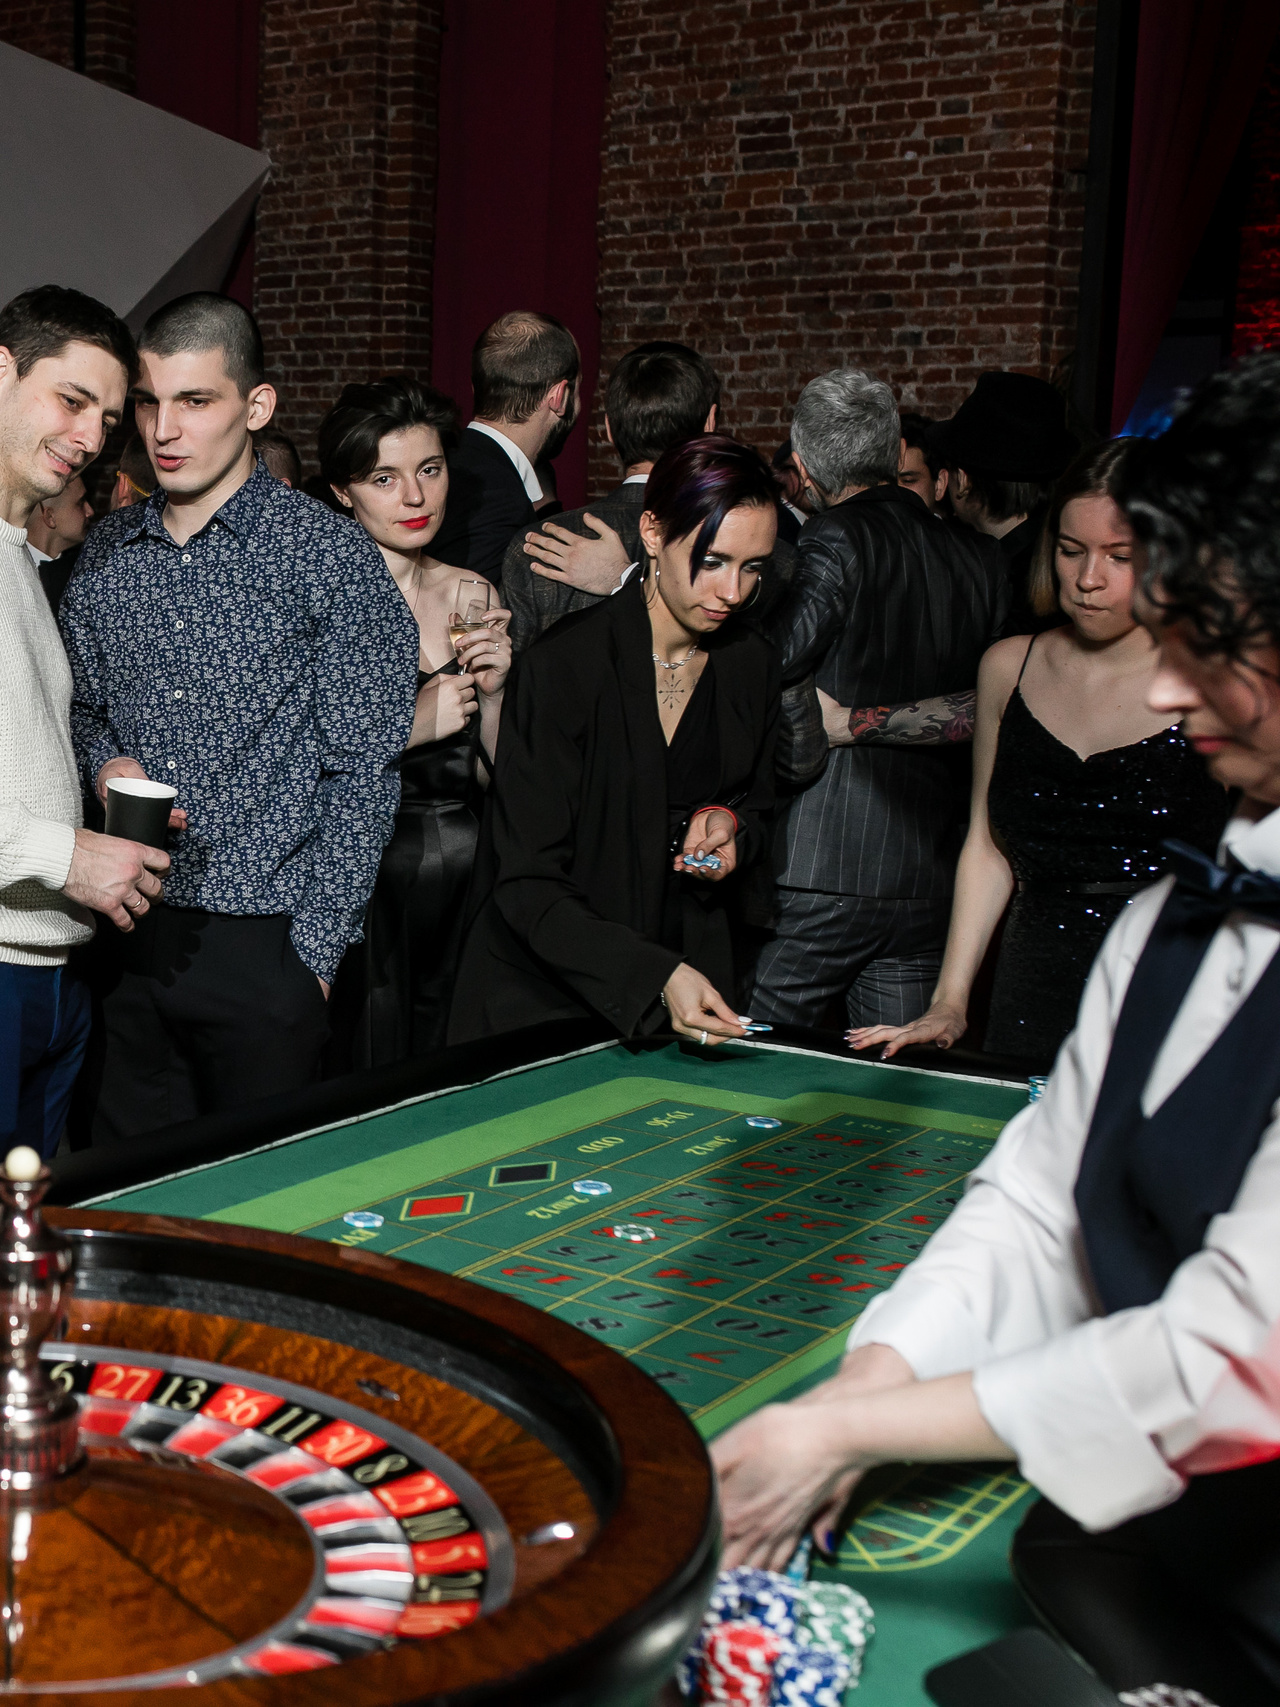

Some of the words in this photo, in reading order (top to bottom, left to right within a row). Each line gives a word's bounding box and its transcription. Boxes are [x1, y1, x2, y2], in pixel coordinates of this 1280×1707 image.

[577, 1136, 624, 1153] ODD
[741, 1161, 820, 1176] 30
[867, 1162, 948, 1178] 32
[705, 1176, 786, 1191] 27
[629, 1208, 708, 1226] 21
[763, 1212, 848, 1231] 23
[727, 1230, 810, 1247] 20
[546, 1246, 621, 1264] 15
[833, 1254, 908, 1272] 19
[500, 1265, 582, 1287] 12
[648, 1267, 732, 1289] 14
[790, 1273, 887, 1294] 16
[608, 1291, 678, 1311] 11
[755, 1294, 835, 1315] 13
[575, 1316, 625, 1332] 8
[714, 1318, 795, 1339] 10
[687, 1349, 741, 1364] 7
[94, 1365, 151, 1401] 27
[154, 1376, 208, 1411] 13
[203, 1387, 268, 1426] 36
[262, 1406, 322, 1443] 11
[303, 1425, 373, 1465] 30
[352, 1453, 409, 1484] 8
[376, 1474, 450, 1514] 23
[401, 1506, 470, 1542] 10
